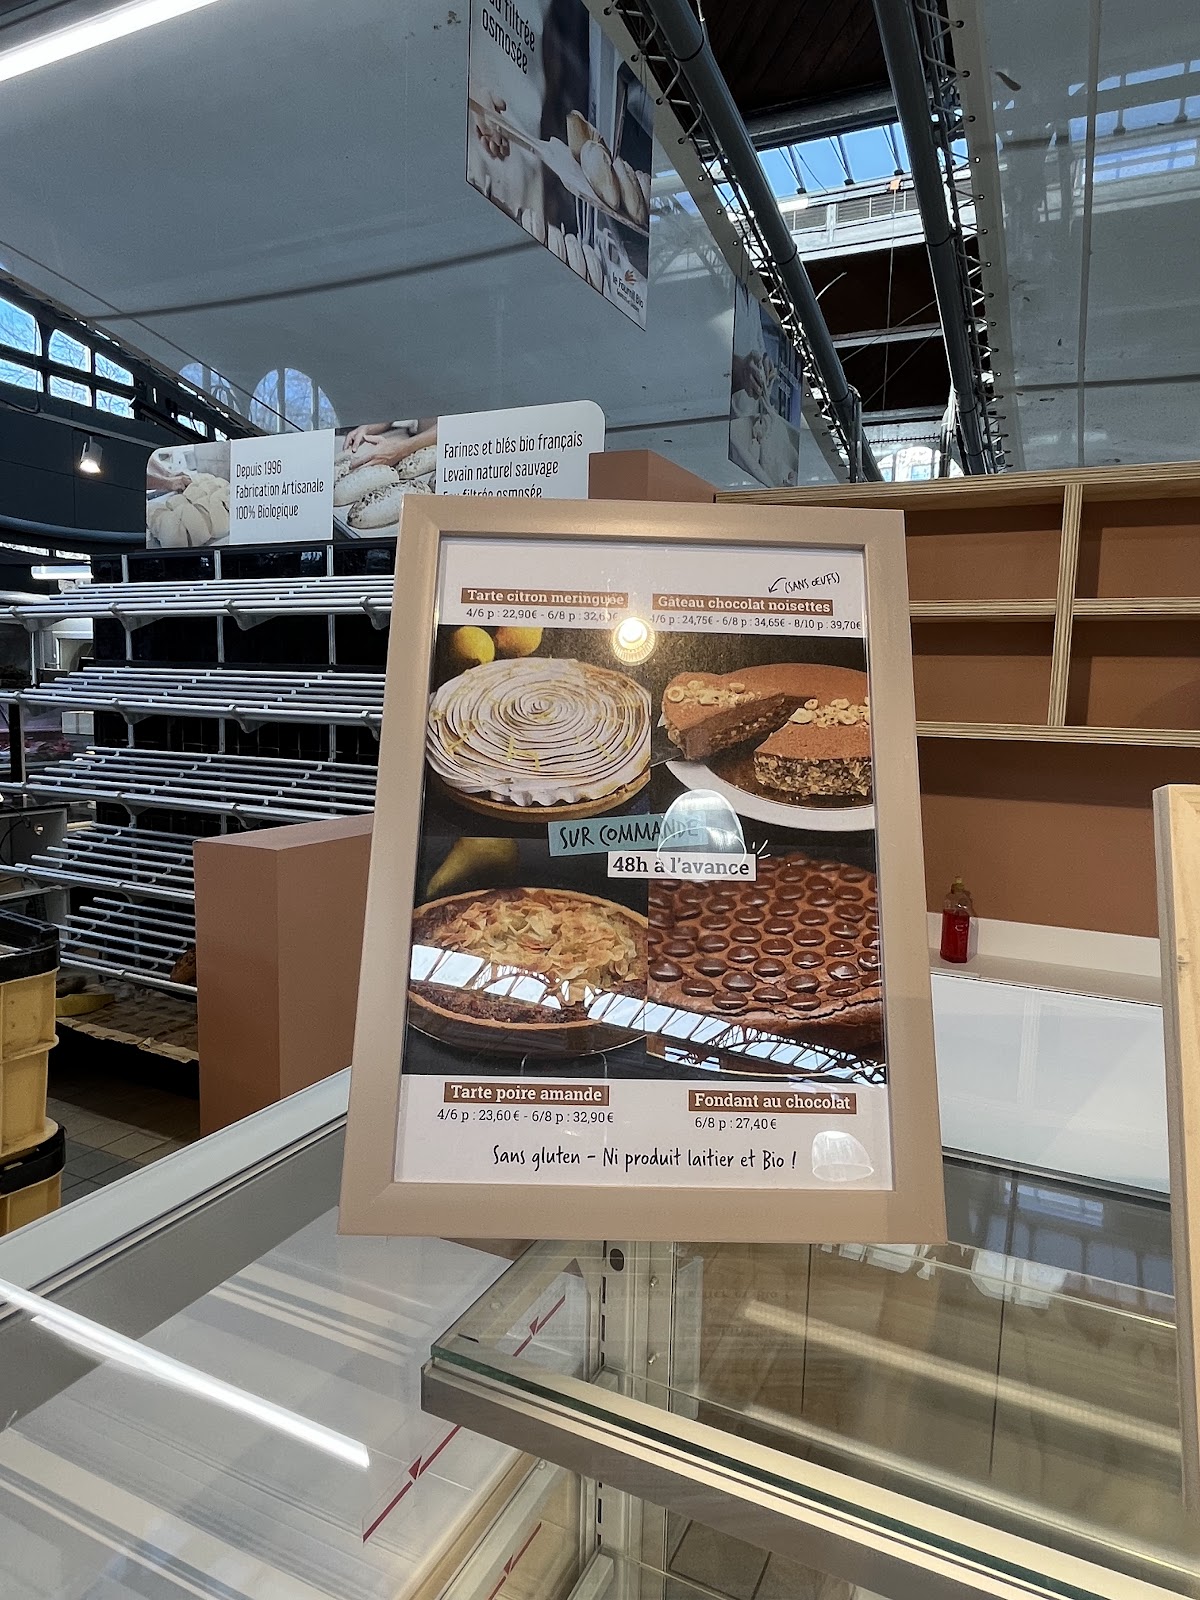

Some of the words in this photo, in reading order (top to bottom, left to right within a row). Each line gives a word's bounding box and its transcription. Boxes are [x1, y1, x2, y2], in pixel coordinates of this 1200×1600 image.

[482, 8, 528, 75] osmosée
[444, 441, 479, 459] Farines
[482, 440, 493, 456] et
[496, 436, 517, 454] blés
[519, 435, 535, 452] bio
[538, 430, 583, 452] français
[236, 463, 262, 479] Depuis
[264, 460, 282, 475] 1996
[443, 464, 473, 483] Levain
[476, 461, 513, 480] naturel
[515, 460, 559, 478] sauvage
[236, 484, 280, 499] Fabrication
[282, 478, 324, 495] Artisanale
[235, 504, 256, 520] 100%
[257, 503, 299, 521] Biologique
[467, 589, 504, 602] Tarte
[506, 591, 548, 603] citron
[658, 595, 705, 608] Gâteau
[708, 597, 765, 611] chocolat
[768, 600, 831, 613] noisettes
[466, 608, 484, 618] 4/6
[502, 609, 538, 619] 22,90€
[547, 611, 565, 621] 6/8
[683, 615, 713, 626] 24,75€
[722, 617, 738, 626] 6/8
[754, 617, 785, 628] 34,65€
[794, 619, 815, 629] 8/10
[830, 620, 861, 631] 39,70€
[559, 826, 595, 850] SUR
[599, 818, 700, 846] COMMANDE
[612, 856, 649, 873] 48h
[670, 857, 750, 876] l'avance
[451, 1084, 492, 1099] Tarte
[496, 1085, 536, 1103] poire
[540, 1086, 602, 1102] amande
[694, 1092, 759, 1108] Fondant
[763, 1097, 782, 1109] au
[785, 1094, 851, 1110] chocolat
[437, 1109, 458, 1121] 4/6
[532, 1111, 552, 1122] 6/8
[695, 1116, 715, 1129] 6/8
[493, 1144, 526, 1165] Sans
[531, 1145, 581, 1171] gluten
[602, 1147, 619, 1167] Ni
[625, 1148, 682, 1173] produit
[687, 1148, 735, 1168] laitier
[740, 1151, 756, 1168] et
[762, 1149, 785, 1171] Bio
